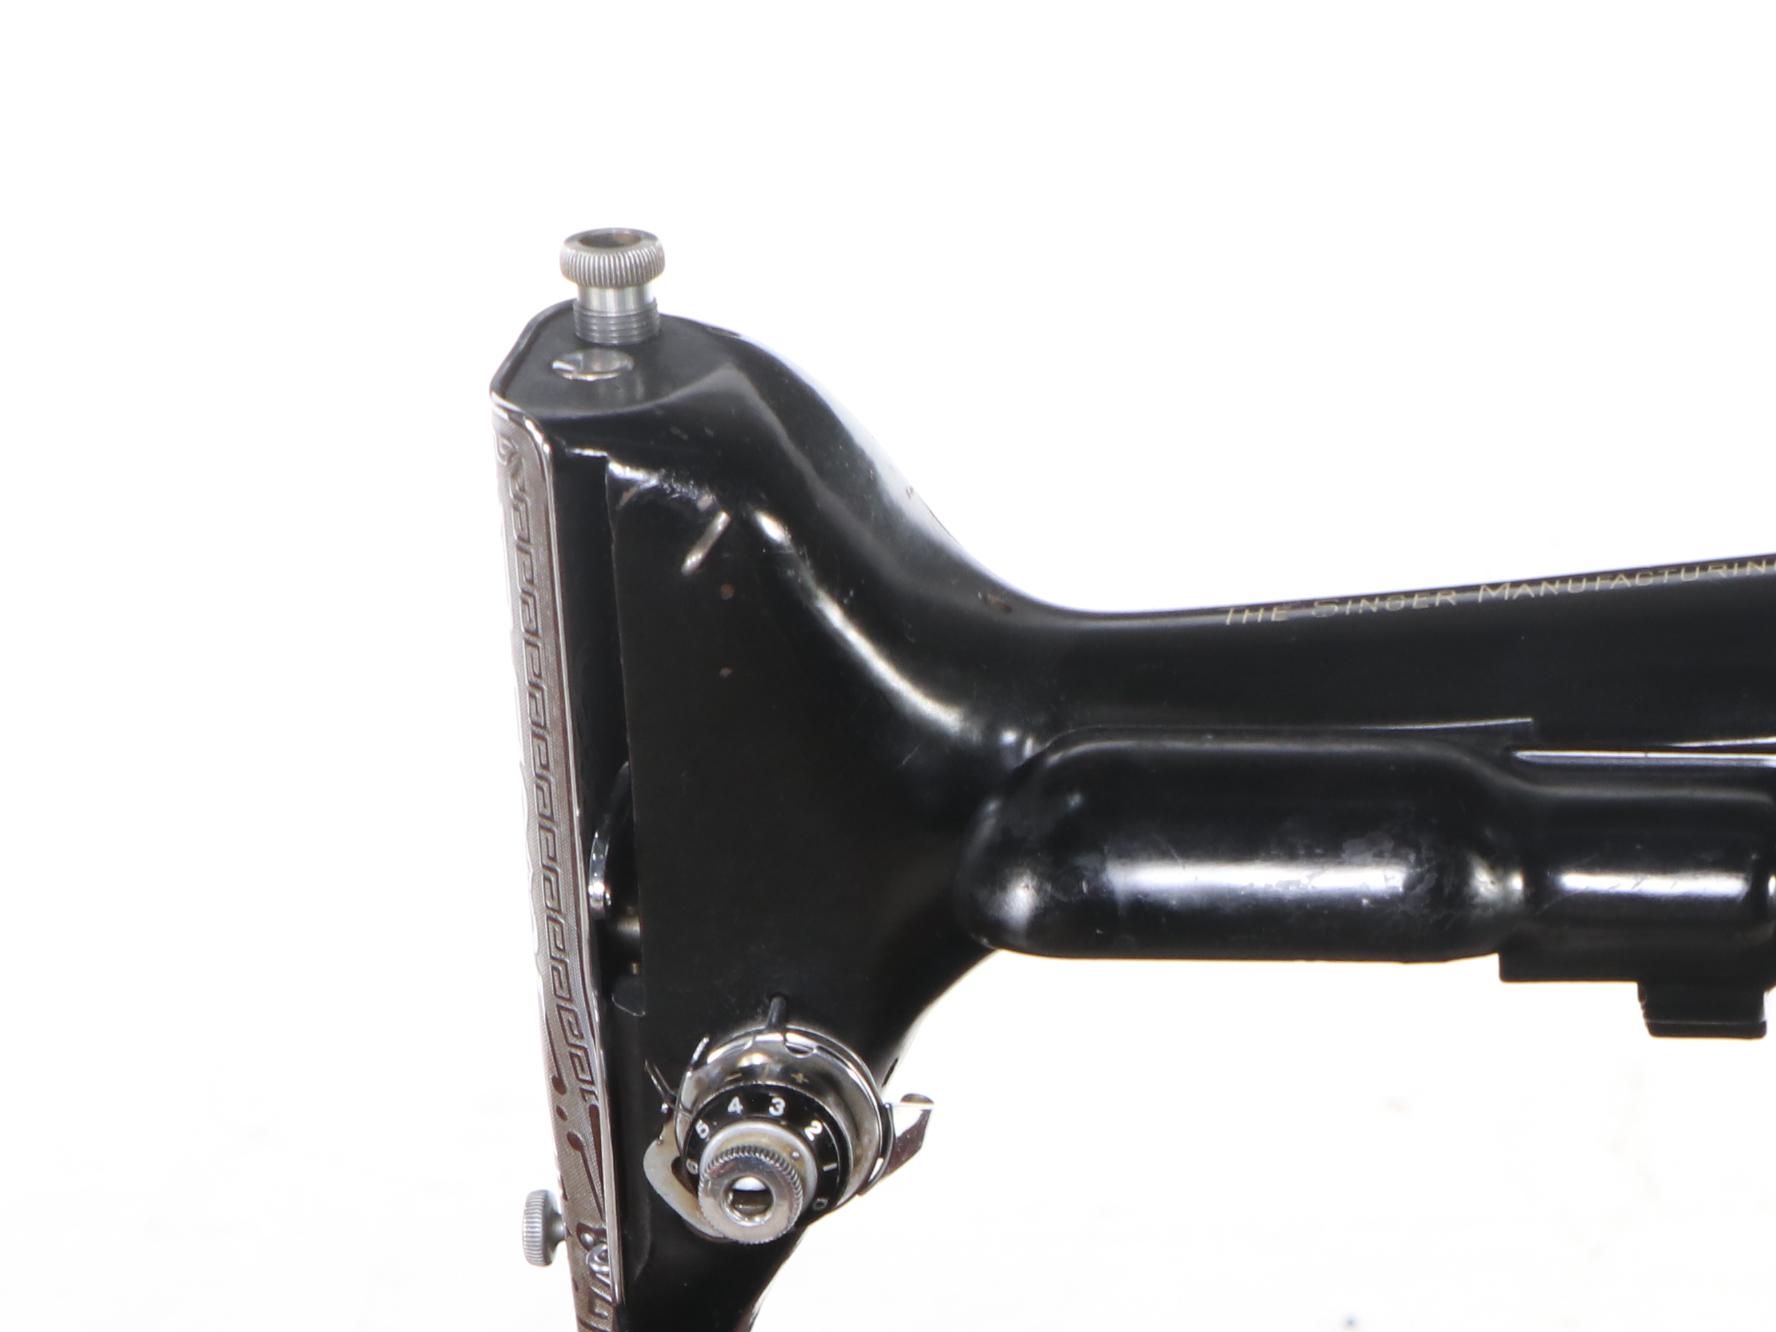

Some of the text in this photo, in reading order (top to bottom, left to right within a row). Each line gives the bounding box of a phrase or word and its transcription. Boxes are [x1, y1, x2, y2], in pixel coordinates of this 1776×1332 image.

[1225, 605, 1290, 625] THE
[1312, 589, 1457, 619] SINGER
[695, 1119, 709, 1140] 5
[727, 1096, 744, 1115] 4
[768, 1097, 786, 1116] 3
[804, 1120, 823, 1141] 2
